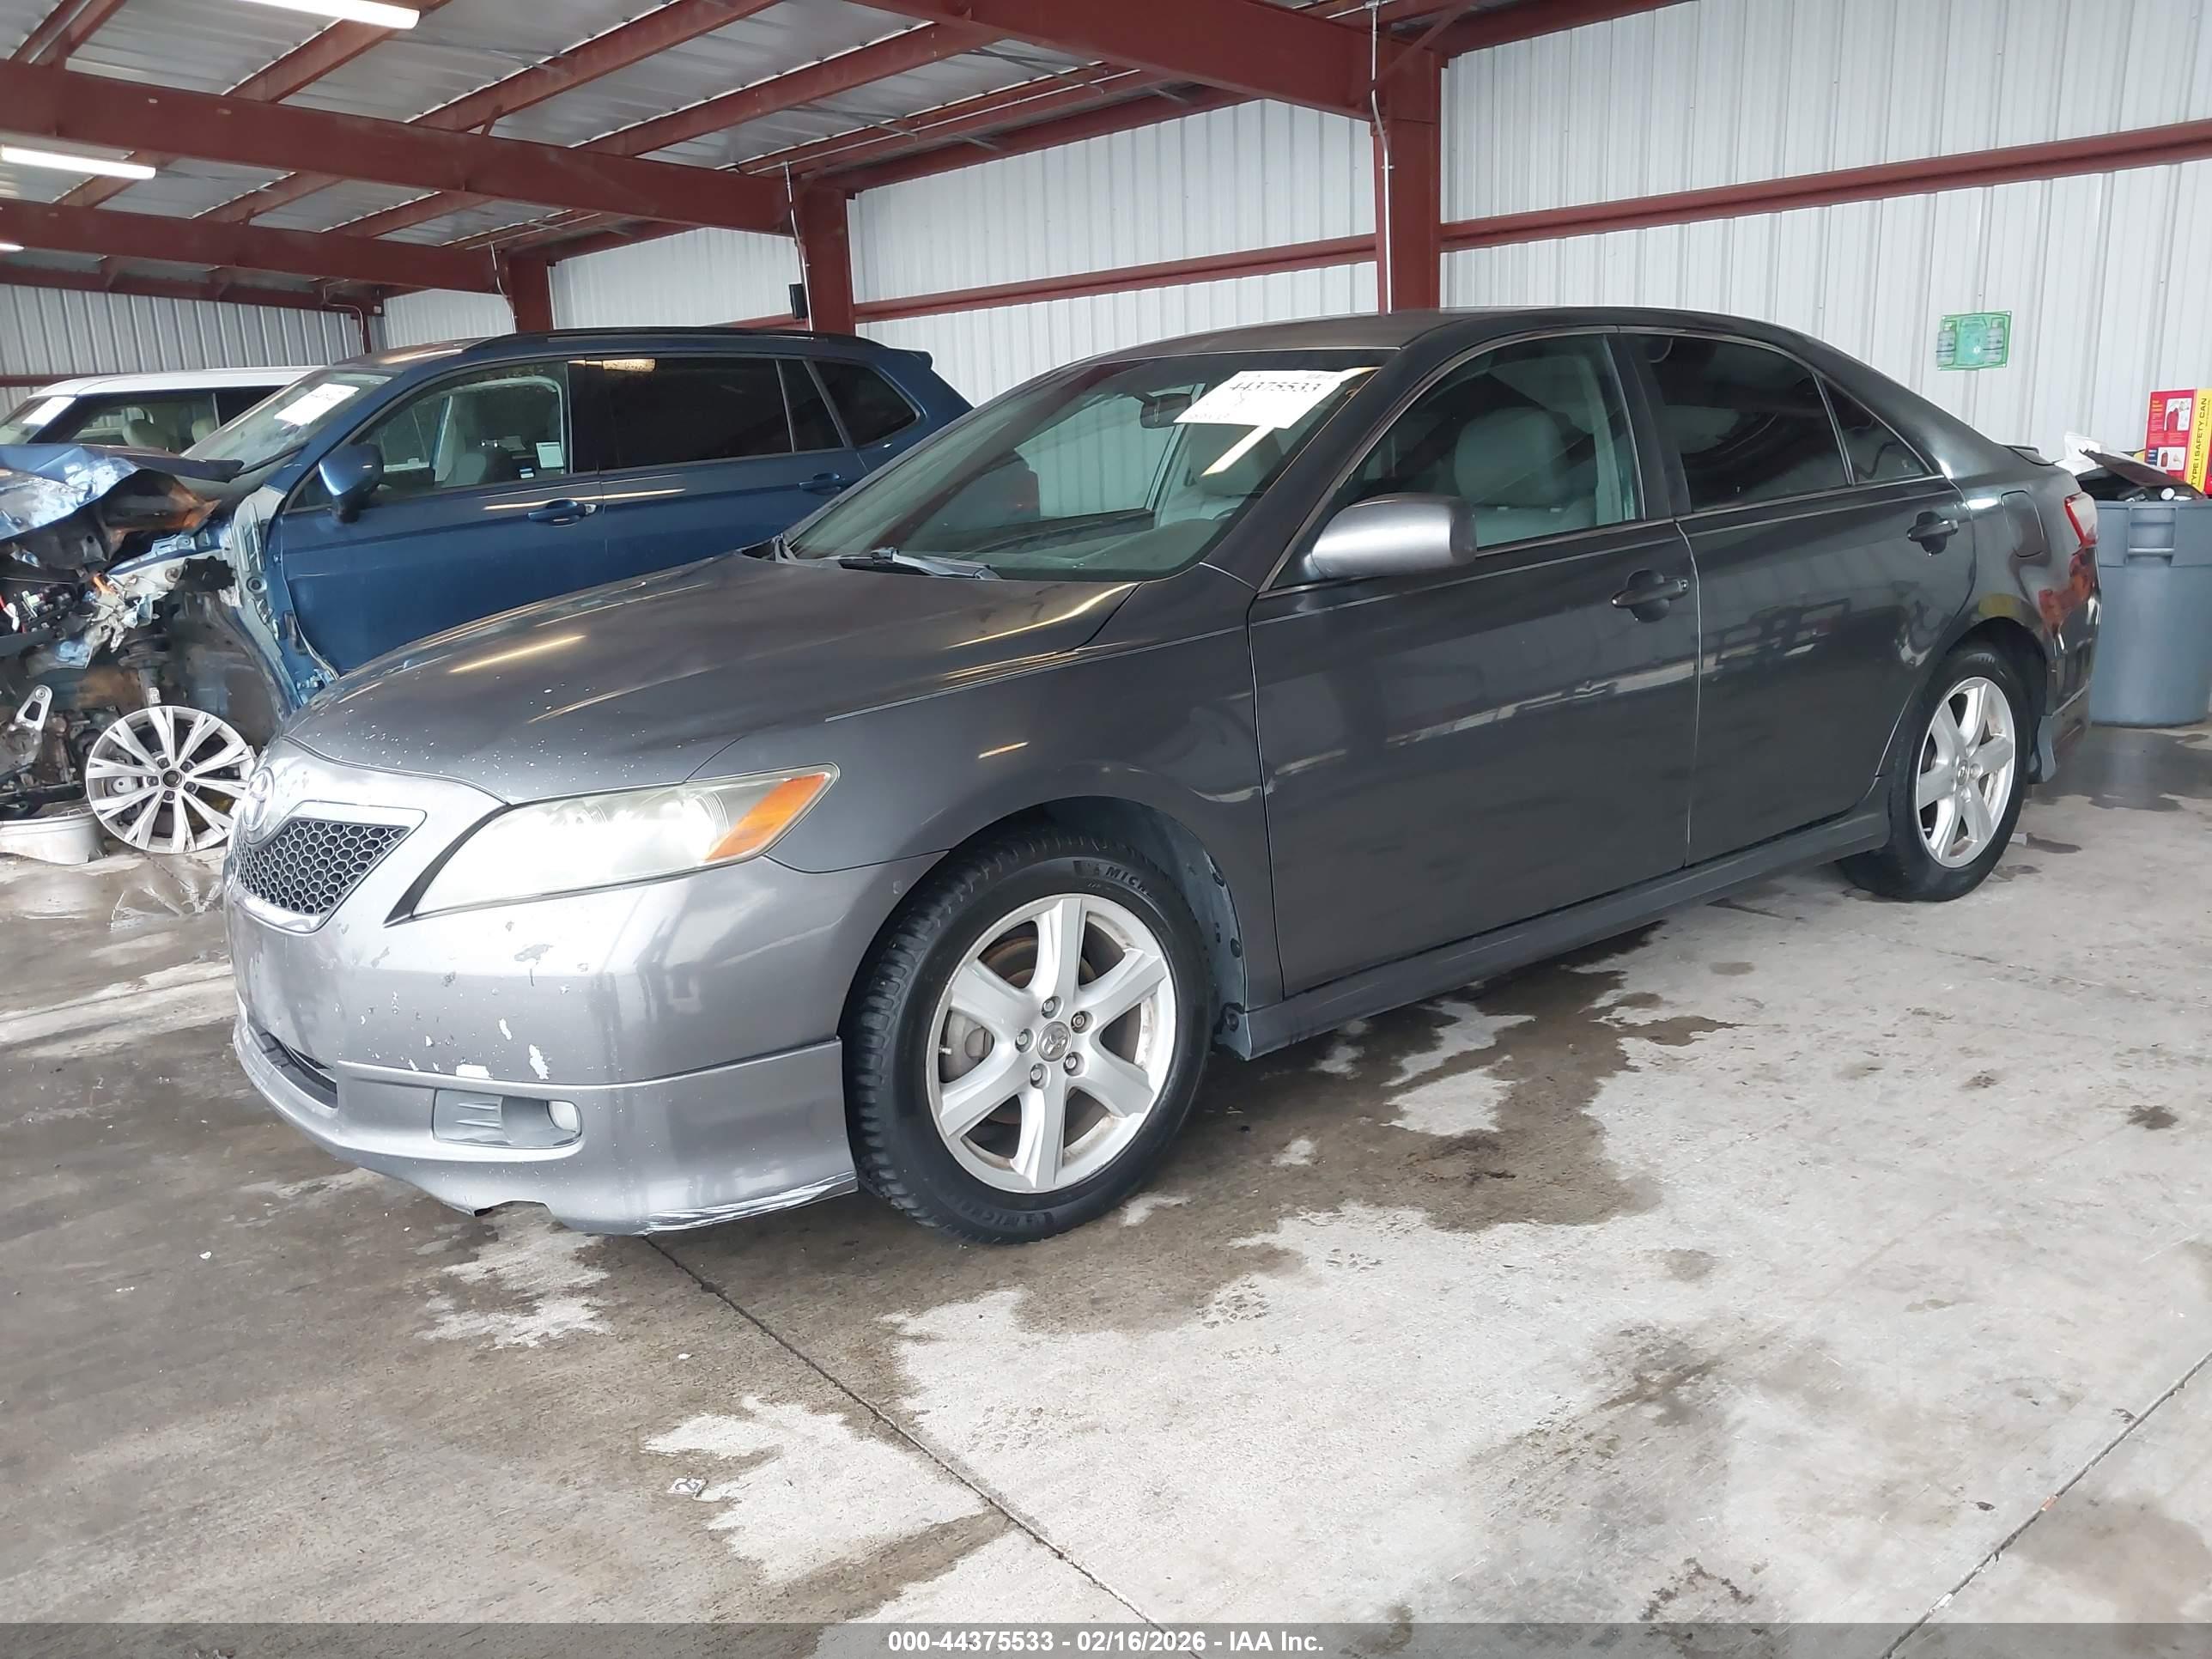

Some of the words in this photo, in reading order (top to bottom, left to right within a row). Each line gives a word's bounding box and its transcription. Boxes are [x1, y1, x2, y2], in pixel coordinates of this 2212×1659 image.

[2199, 398, 2208, 419] CAN
[2194, 421, 2204, 457] SAFETY
[2191, 462, 2199, 485] TYPE
